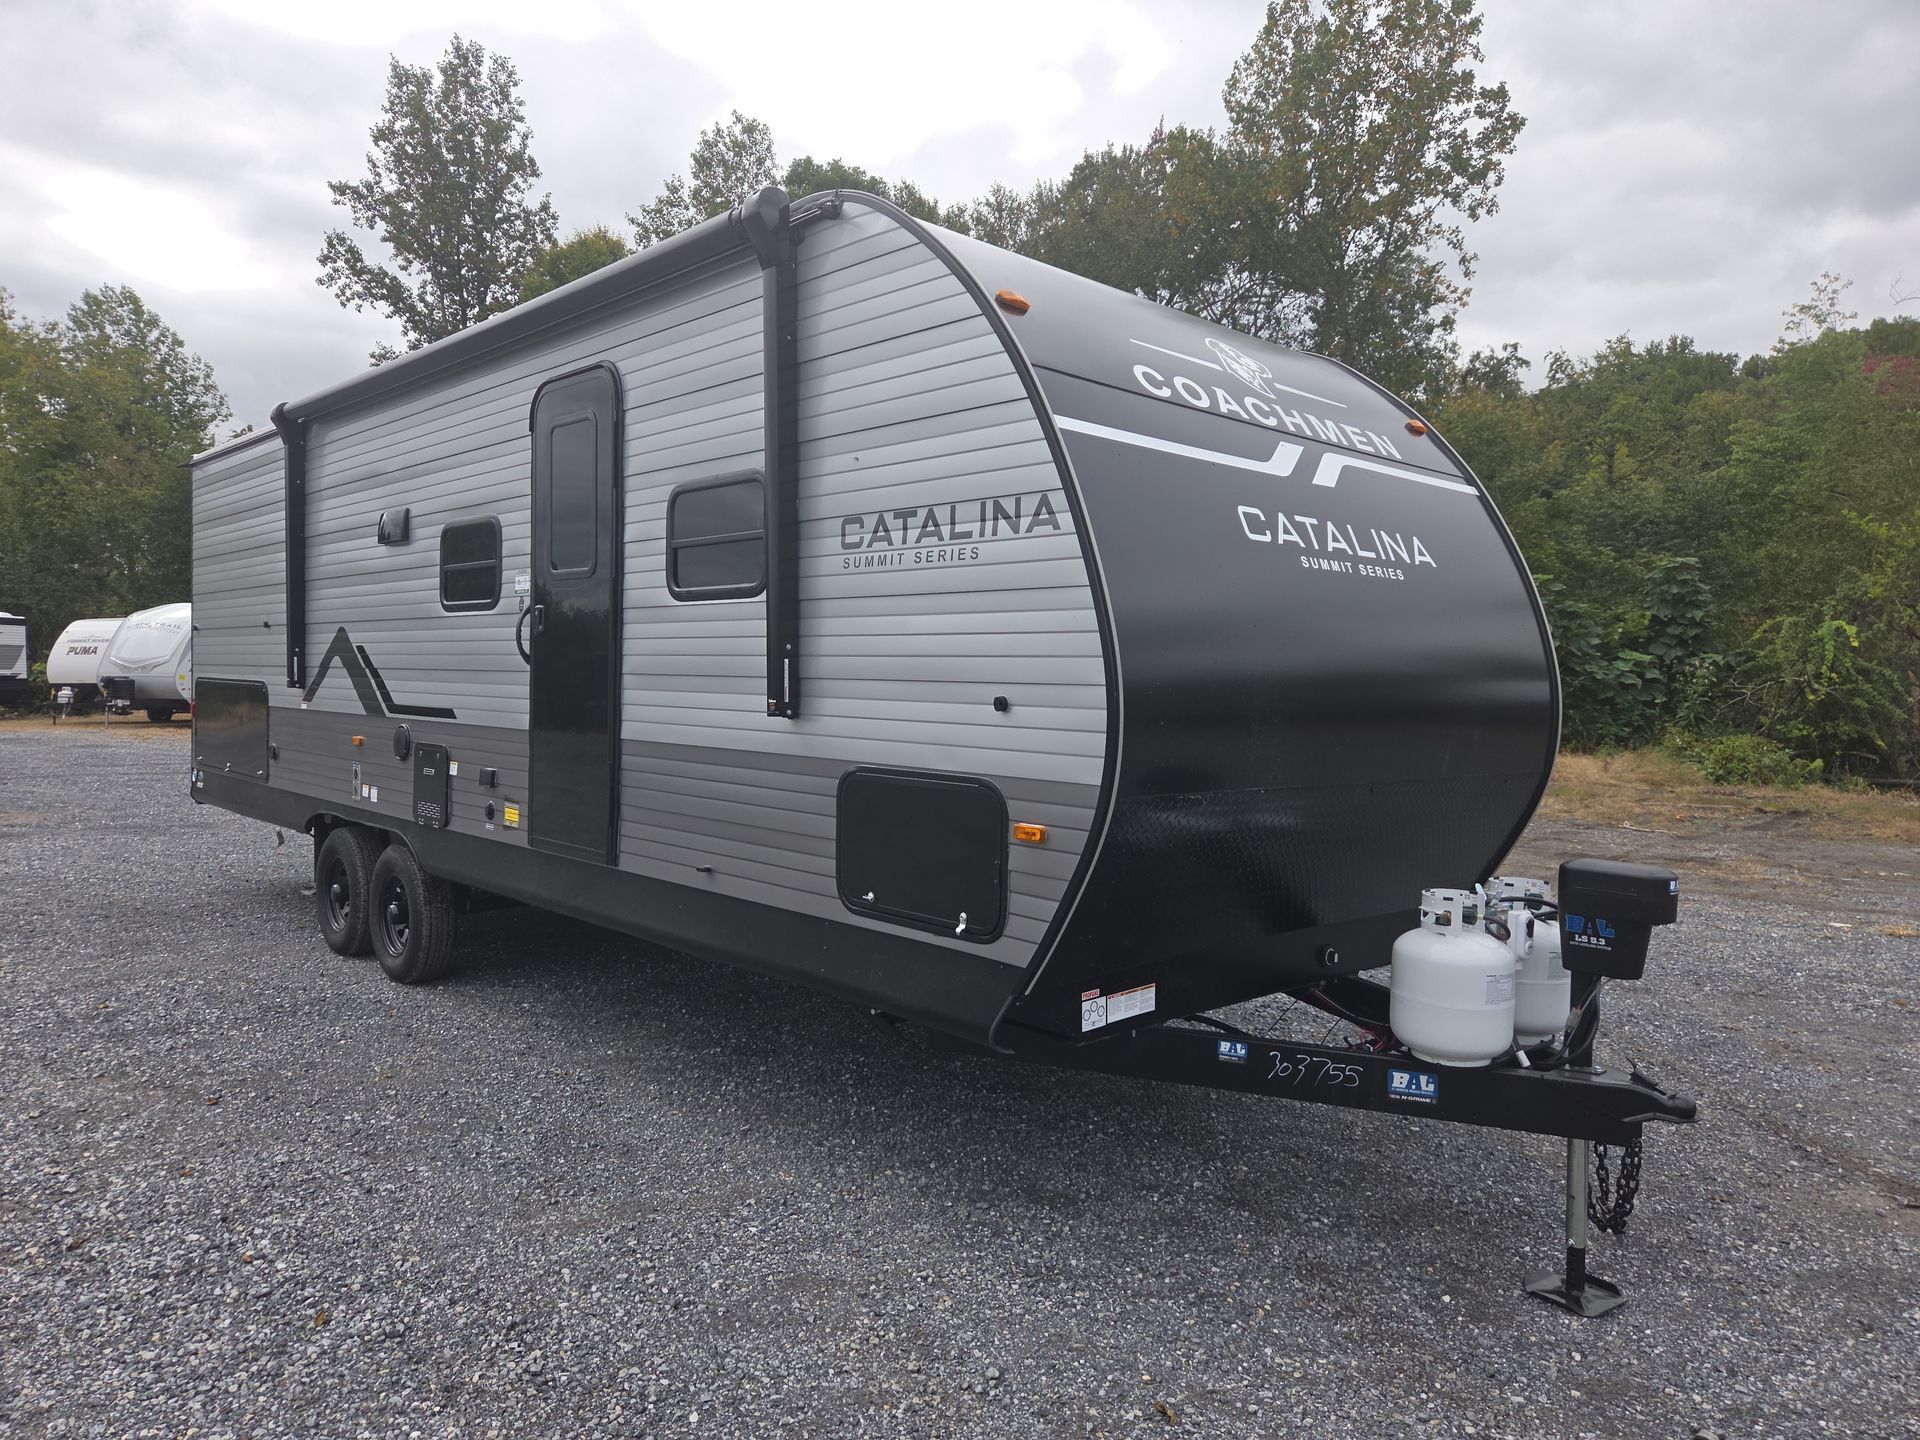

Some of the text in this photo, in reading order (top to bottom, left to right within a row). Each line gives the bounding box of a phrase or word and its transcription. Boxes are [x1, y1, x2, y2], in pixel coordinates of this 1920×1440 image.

[1132, 364, 1403, 460] COACHMEN
[840, 493, 1062, 551] CATALINA
[1237, 505, 1438, 568] CATALINA
[843, 546, 980, 570] SUMMIT SERIES
[1300, 555, 1405, 581] SUMMIT SERIES
[66, 646, 98, 656] PUMA
[1574, 934, 1588, 943] LS
[1082, 989, 1099, 1000] PROPANE
[1268, 1051, 1364, 1087] 303755
